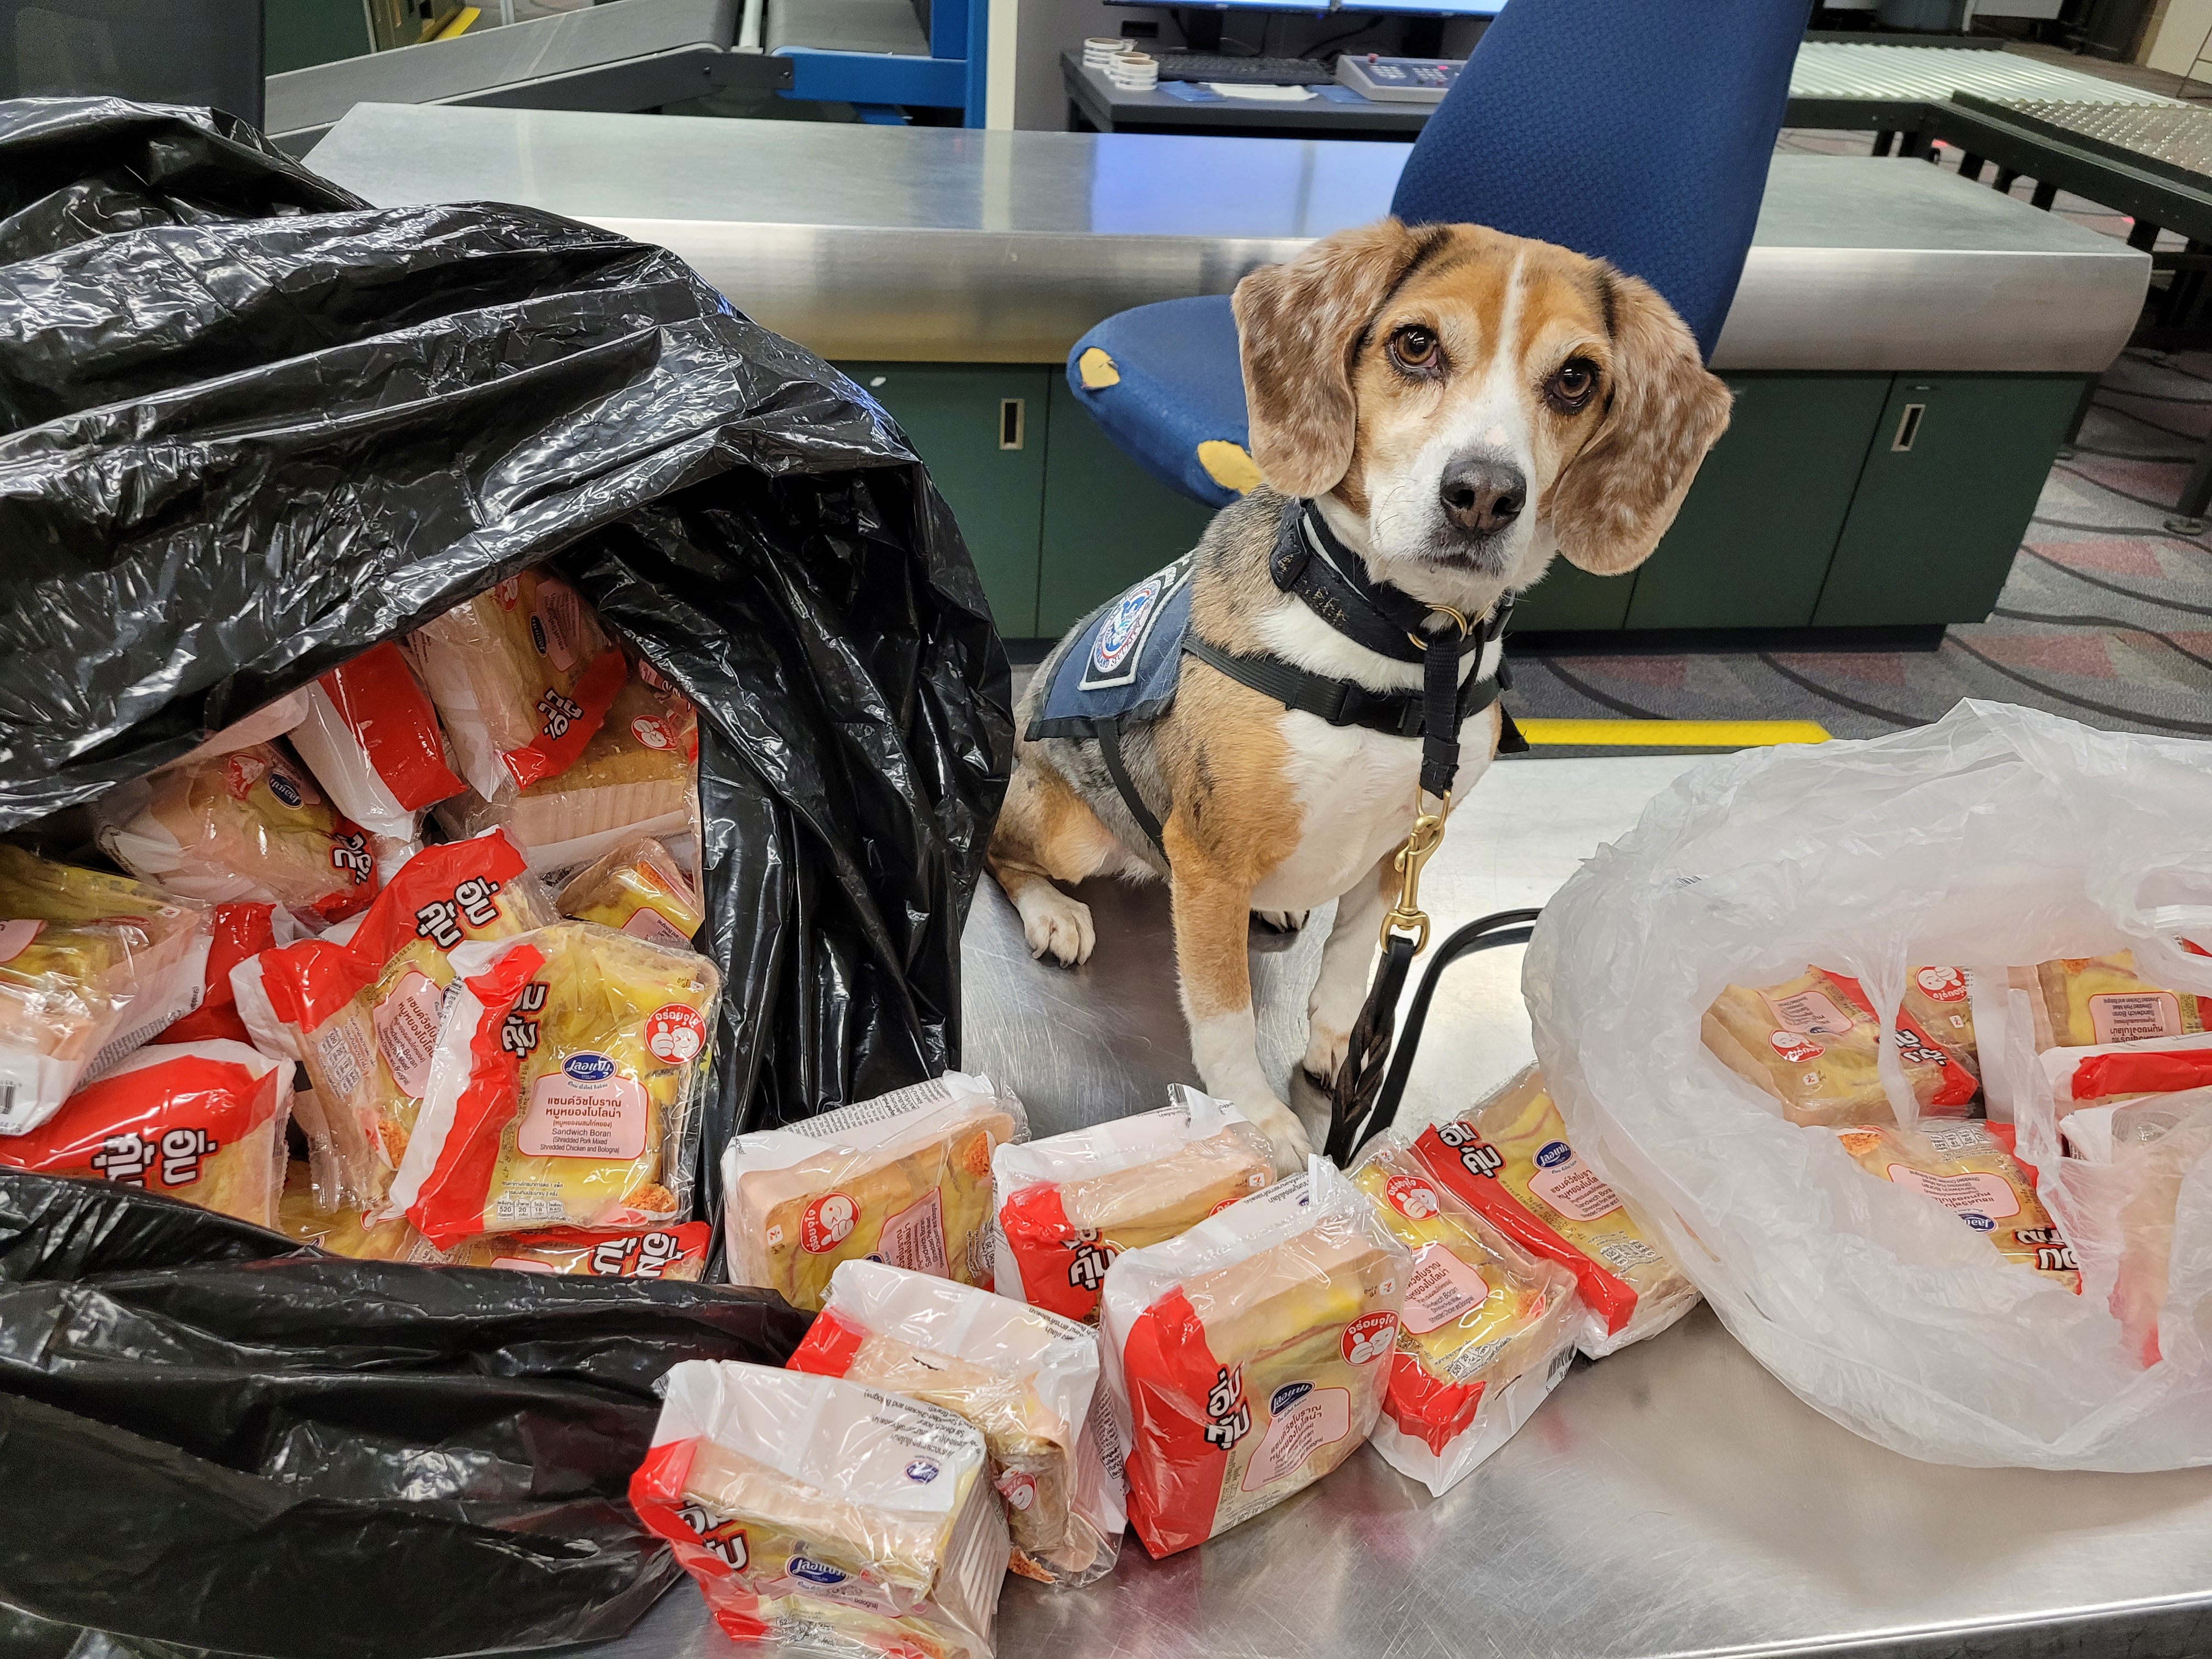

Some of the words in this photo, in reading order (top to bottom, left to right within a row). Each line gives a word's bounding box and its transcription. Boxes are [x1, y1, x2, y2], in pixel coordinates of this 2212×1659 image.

[535, 702, 569, 739] อิ่ม
[455, 877, 499, 926] อิ่ม
[417, 901, 462, 947] คุ้ม
[502, 1016, 537, 1057] คุ้ม
[2109, 1024, 2164, 1036] หมูหยองโบโลน่า
[327, 1032, 337, 1045] 520
[335, 1047, 343, 1056] 20
[342, 1060, 350, 1069] 18
[348, 1071, 358, 1083] 840
[397, 1056, 410, 1070] Mixed
[403, 1048, 419, 1069] Boran
[545, 1105, 622, 1120] หมูหยองโบโลน่า
[548, 1095, 622, 1108] แซนด์วิชโบราณ
[552, 1128, 588, 1136] Sandwich
[590, 1129, 611, 1137] Boran
[553, 1120, 612, 1128] (หมูหยองผสมไก่หยอง)
[162, 1130, 216, 1184] อิ่ม
[598, 1146, 620, 1155] Bologna)
[1460, 1146, 1502, 1177] คุ้ม
[1540, 1144, 1570, 1167] เลอแปง
[1387, 1177, 1417, 1197] อร่อยจุใจ
[1550, 1169, 1593, 1193] แซนด์วิชโบรา
[1921, 1182, 1940, 1192] Boran
[1599, 1187, 1613, 1198] Bora
[1944, 1197, 1994, 1207] แซนด์วิชโบ
[804, 1209, 821, 1252] อร่อยจุใจ
[918, 1218, 926, 1235] Boran
[1962, 1218, 1990, 1228] เลอแ
[636, 1233, 685, 1277] อิ่ม
[903, 1222, 917, 1271] ูหยองโบโลน่า
[921, 1235, 932, 1267] Sandwich
[985, 1240, 992, 1249] 20
[1070, 1247, 1116, 1289] คุ้ม
[1442, 1285, 1459, 1299] Boran
[1348, 1313, 1395, 1335] อร่อยจุใจ
[1451, 1364, 1463, 1376] 520
[1460, 1352, 1469, 1362] 20
[1209, 1367, 1241, 1417] อิ่ม
[1207, 1403, 1250, 1449] คุ้ม
